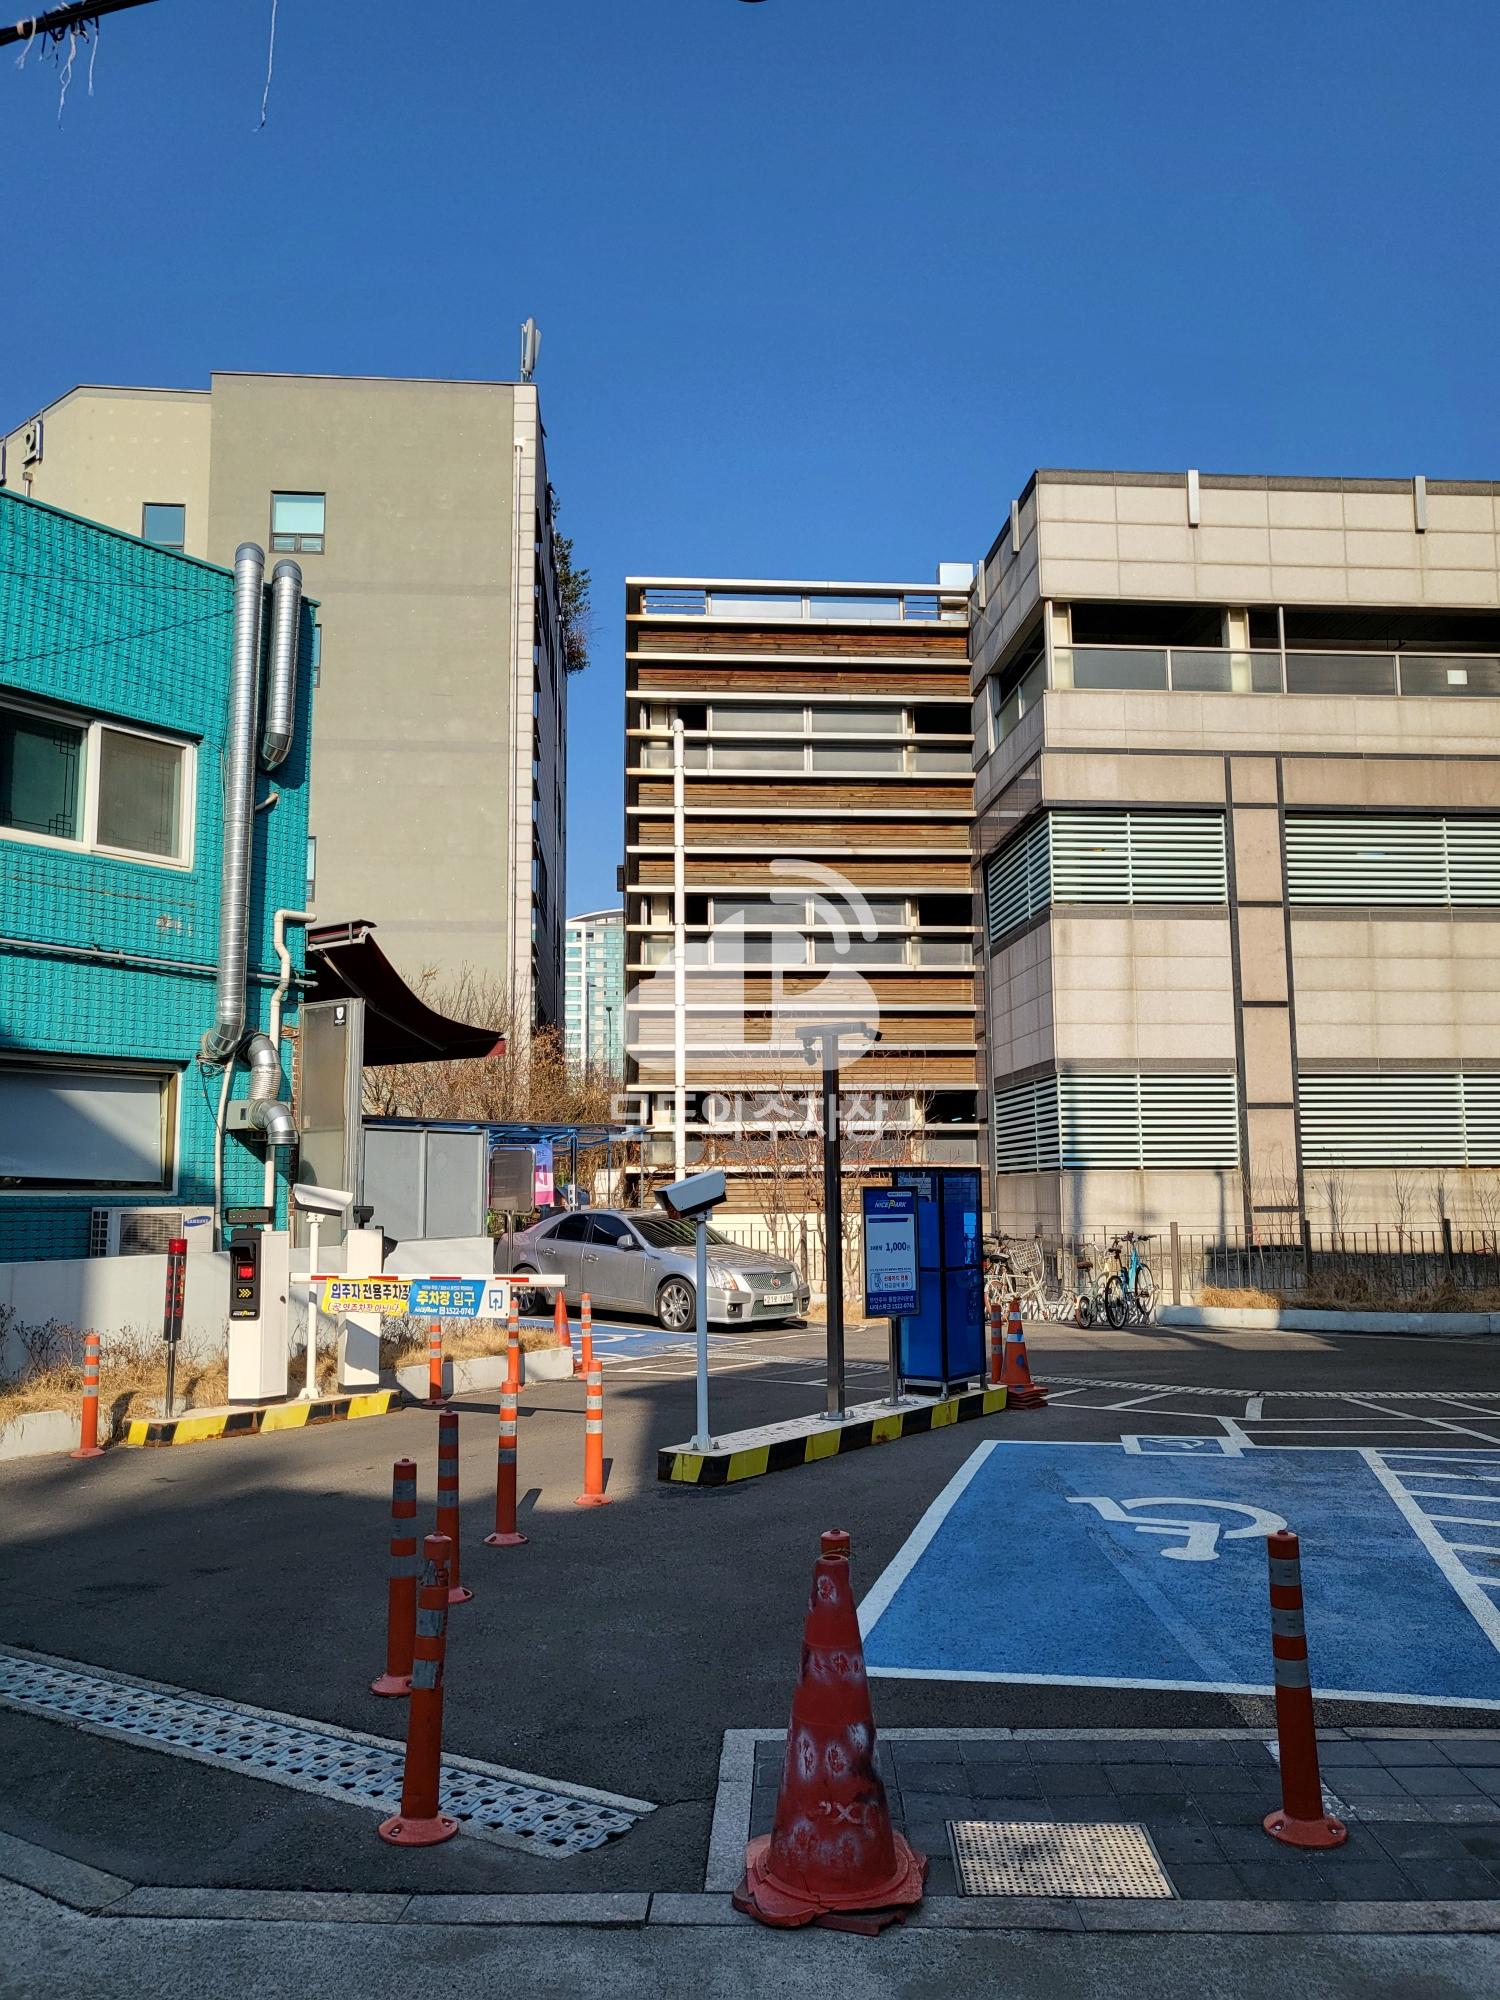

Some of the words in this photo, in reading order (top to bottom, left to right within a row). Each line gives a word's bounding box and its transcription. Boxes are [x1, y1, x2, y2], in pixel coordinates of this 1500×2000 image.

[331, 1283, 361, 1300] 입주자
[363, 1284, 411, 1301] 전용주차장
[416, 1290, 450, 1305] 주차장
[453, 1291, 475, 1306] 입구
[445, 1307, 475, 1316] 1522-0741
